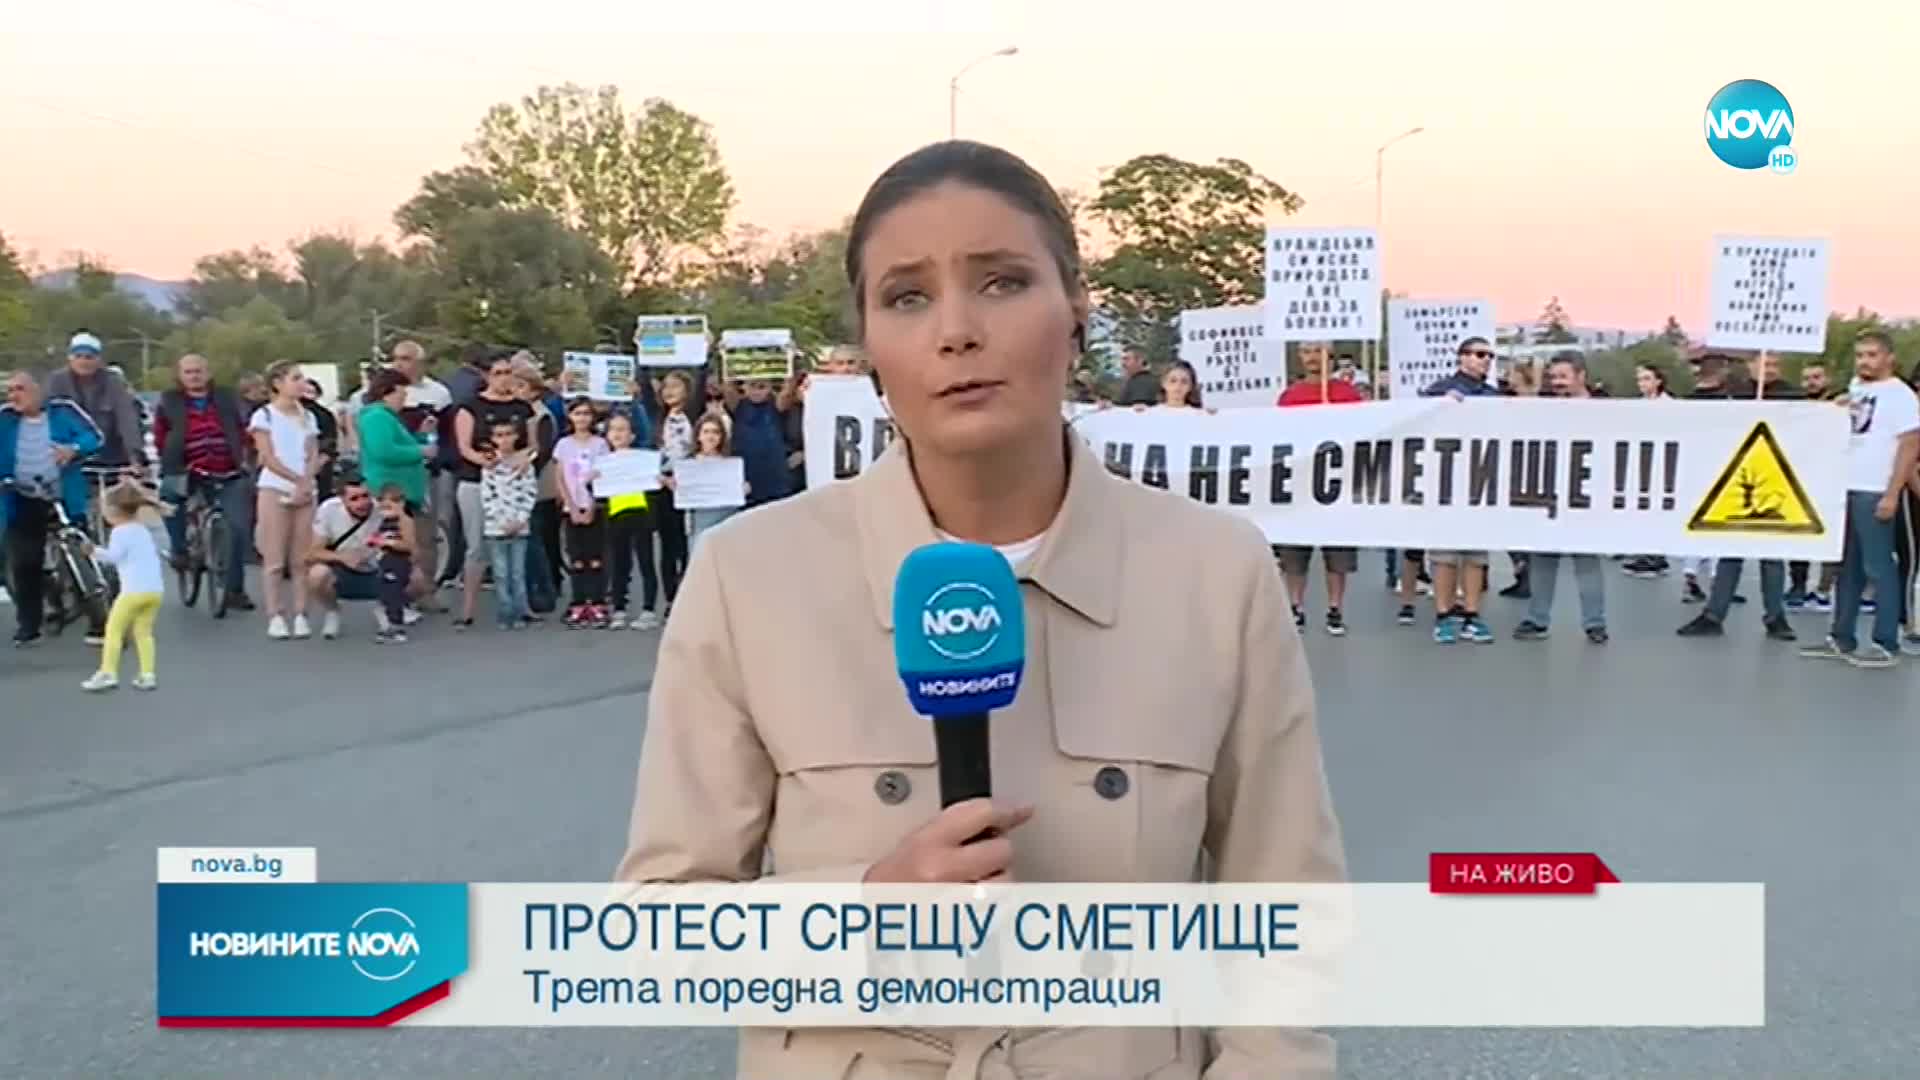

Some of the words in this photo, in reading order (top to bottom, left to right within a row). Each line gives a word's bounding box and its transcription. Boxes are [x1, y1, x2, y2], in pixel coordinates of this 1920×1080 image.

[1288, 253, 1309, 267] СИ
[1189, 444, 1252, 505] НЕ
[1270, 444, 1293, 504] Е
[1312, 438, 1594, 518] СМЕТИЩЕ
[922, 604, 1002, 636] NOVA
